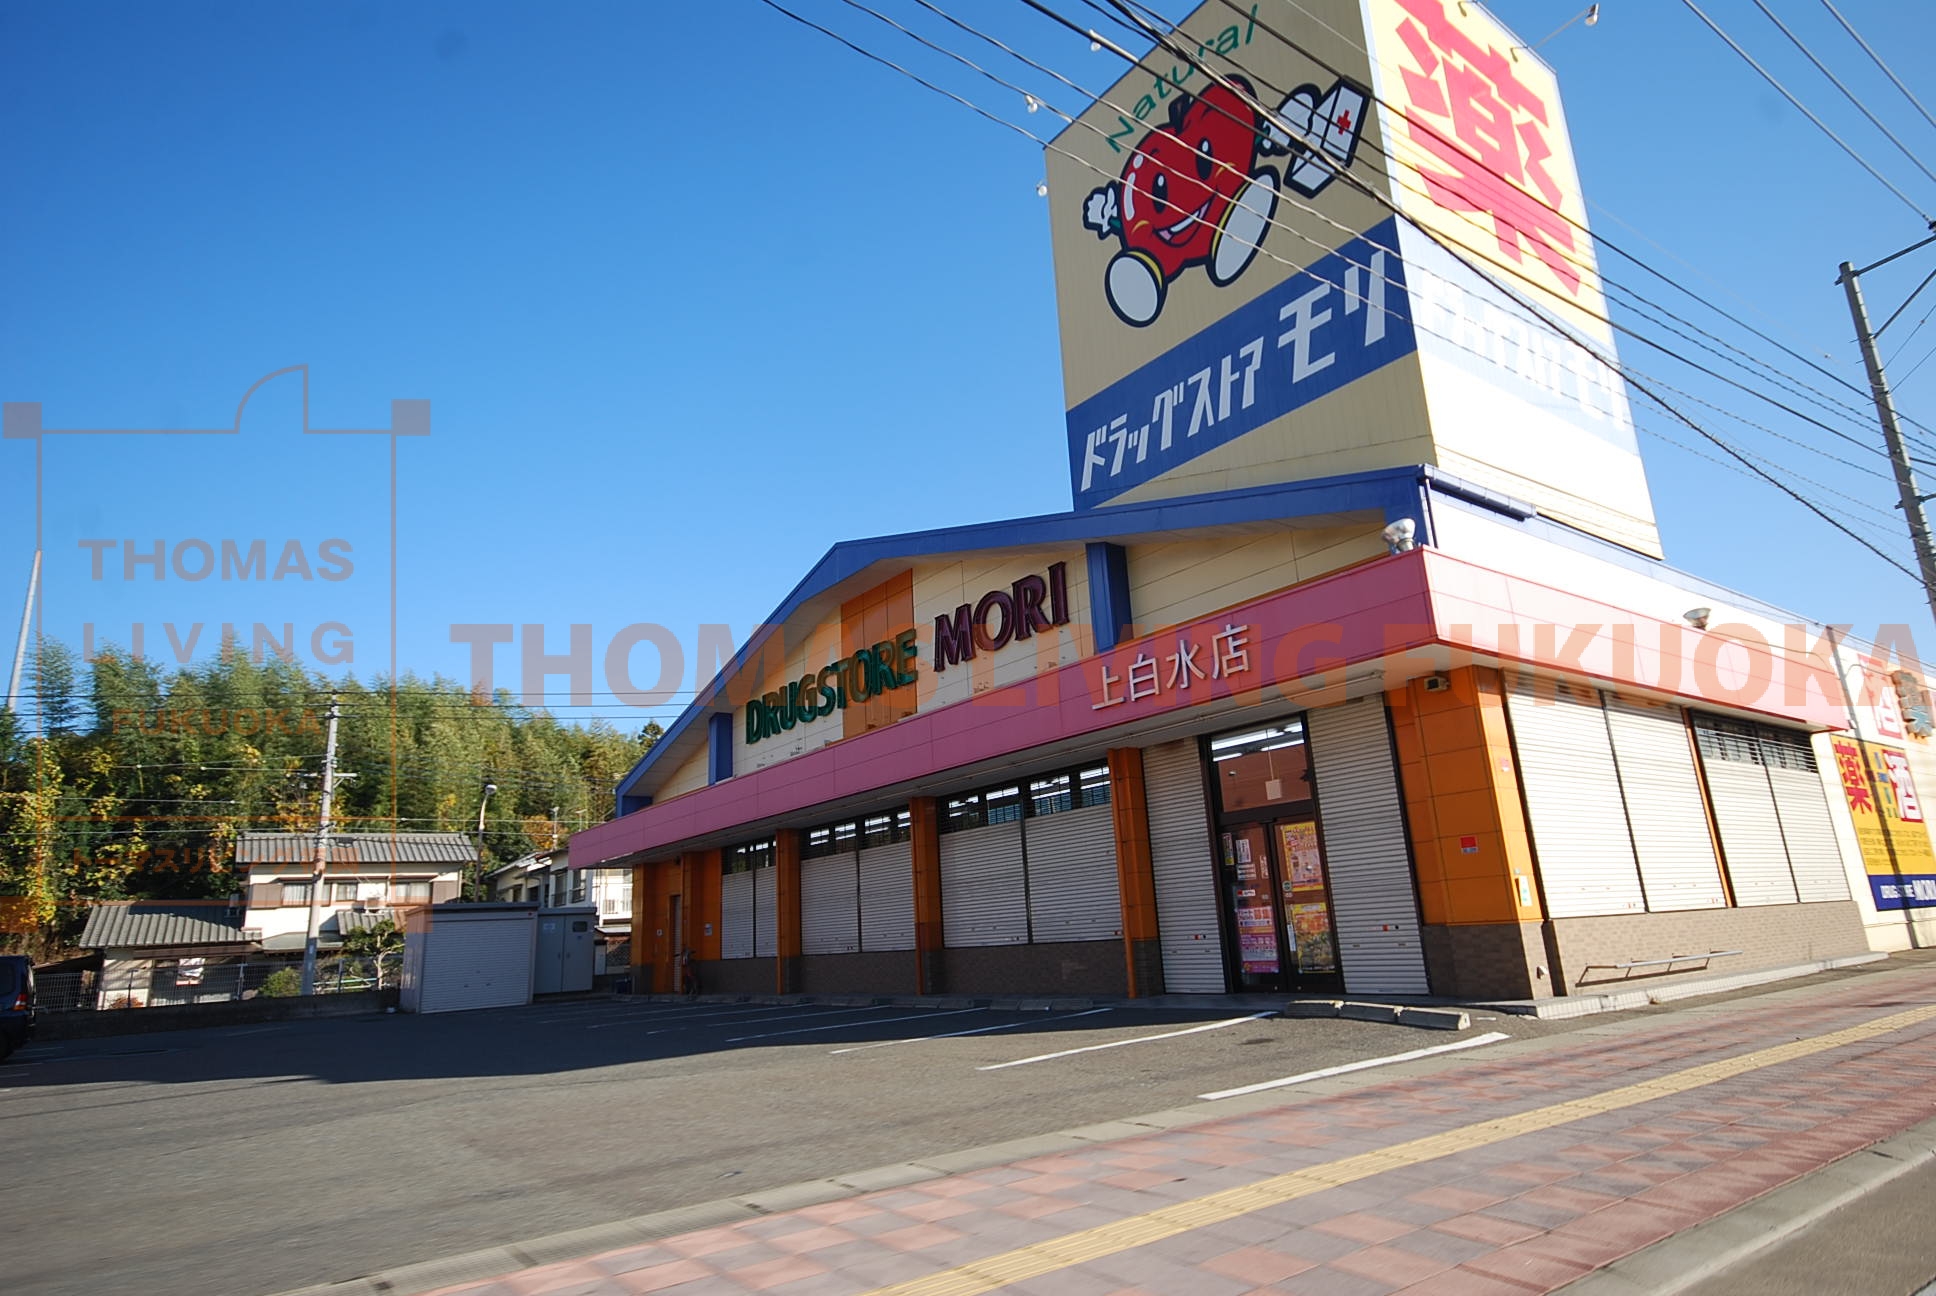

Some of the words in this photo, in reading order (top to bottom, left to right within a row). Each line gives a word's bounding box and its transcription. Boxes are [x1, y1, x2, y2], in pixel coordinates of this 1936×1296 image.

[1106, 4, 1258, 153] Natural
[746, 628, 918, 745] DRUGSTORE
[933, 561, 1070, 673] MORI
[1091, 622, 1251, 711] 上白水店
[1834, 740, 1873, 815] 薬
